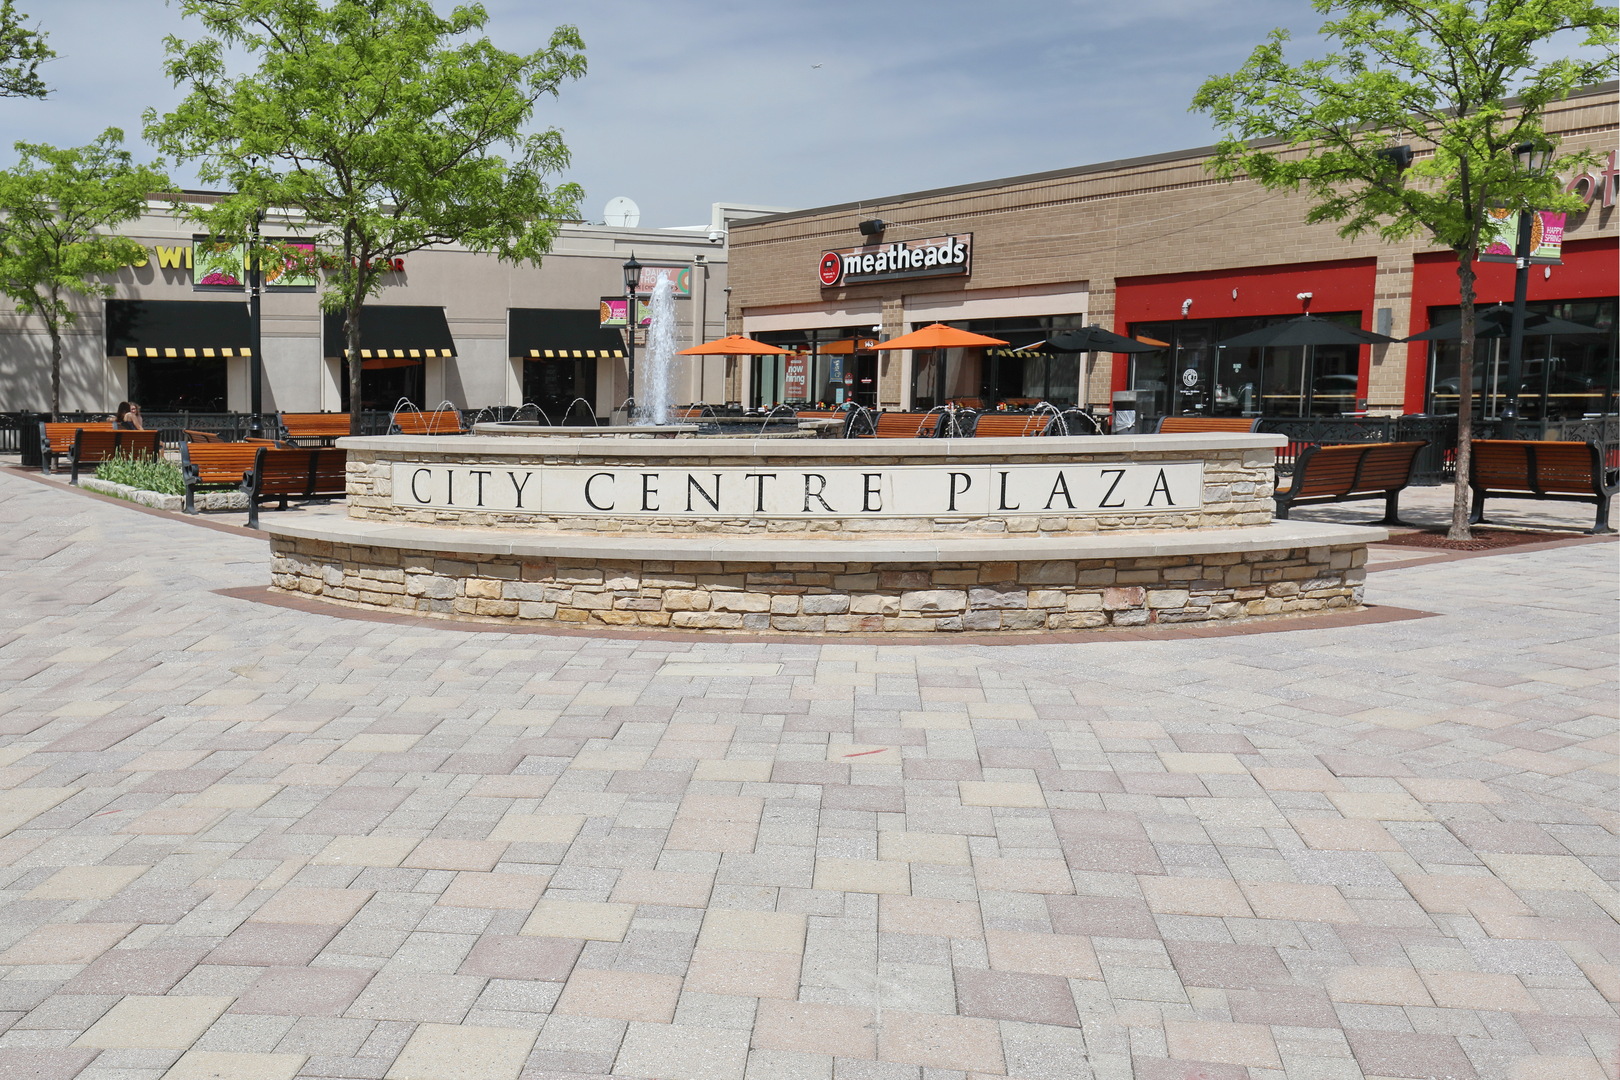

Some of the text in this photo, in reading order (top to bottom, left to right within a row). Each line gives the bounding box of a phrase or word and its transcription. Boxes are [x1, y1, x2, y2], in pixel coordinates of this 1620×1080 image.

[1546, 226, 1563, 234] HAPPY
[1544, 234, 1562, 242] SPRING
[844, 237, 965, 274] meatheads
[788, 365, 803, 373] now
[785, 372, 805, 385] hiring
[411, 467, 1176, 512] CITY CENTRE PLAZA
